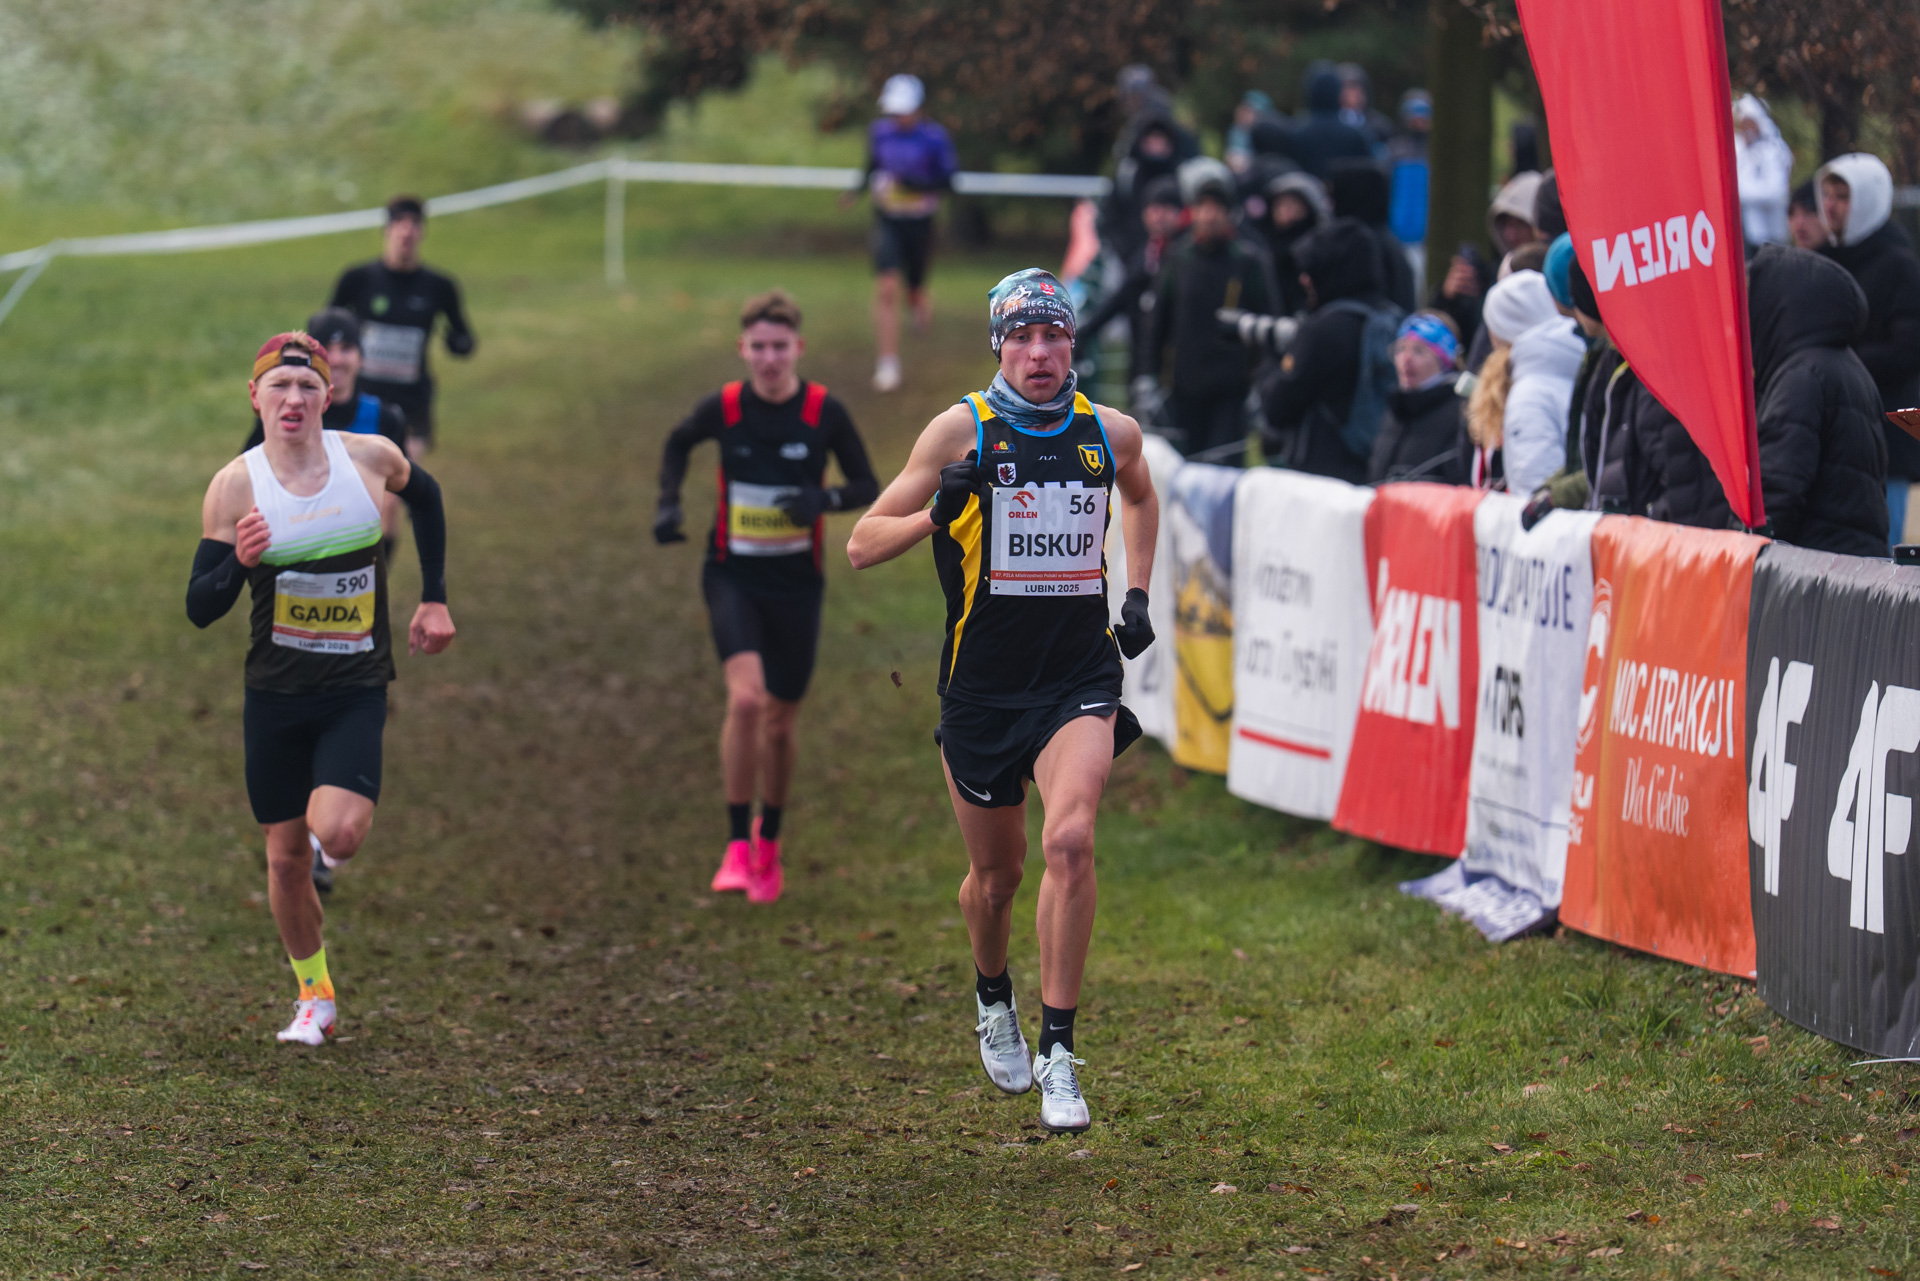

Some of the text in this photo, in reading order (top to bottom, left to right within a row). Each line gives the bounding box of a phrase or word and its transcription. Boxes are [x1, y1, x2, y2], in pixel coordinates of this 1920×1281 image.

[1021, 300, 1045, 308] BIEG
[1008, 511, 1038, 519] ORLEN
[1069, 494, 1096, 515] 56
[1008, 533, 1094, 557] BISKUP
[335, 573, 368, 594] 590
[1025, 584, 1080, 593] LUBIN 2025
[290, 604, 362, 622] GAJDA
[1639, 665, 1735, 759] ATRAKCJI
[1748, 656, 1814, 897] 4F
[1622, 756, 1646, 827] Dla
[1647, 763, 1690, 838] Ciebie
[1827, 679, 1920, 935] 4F
